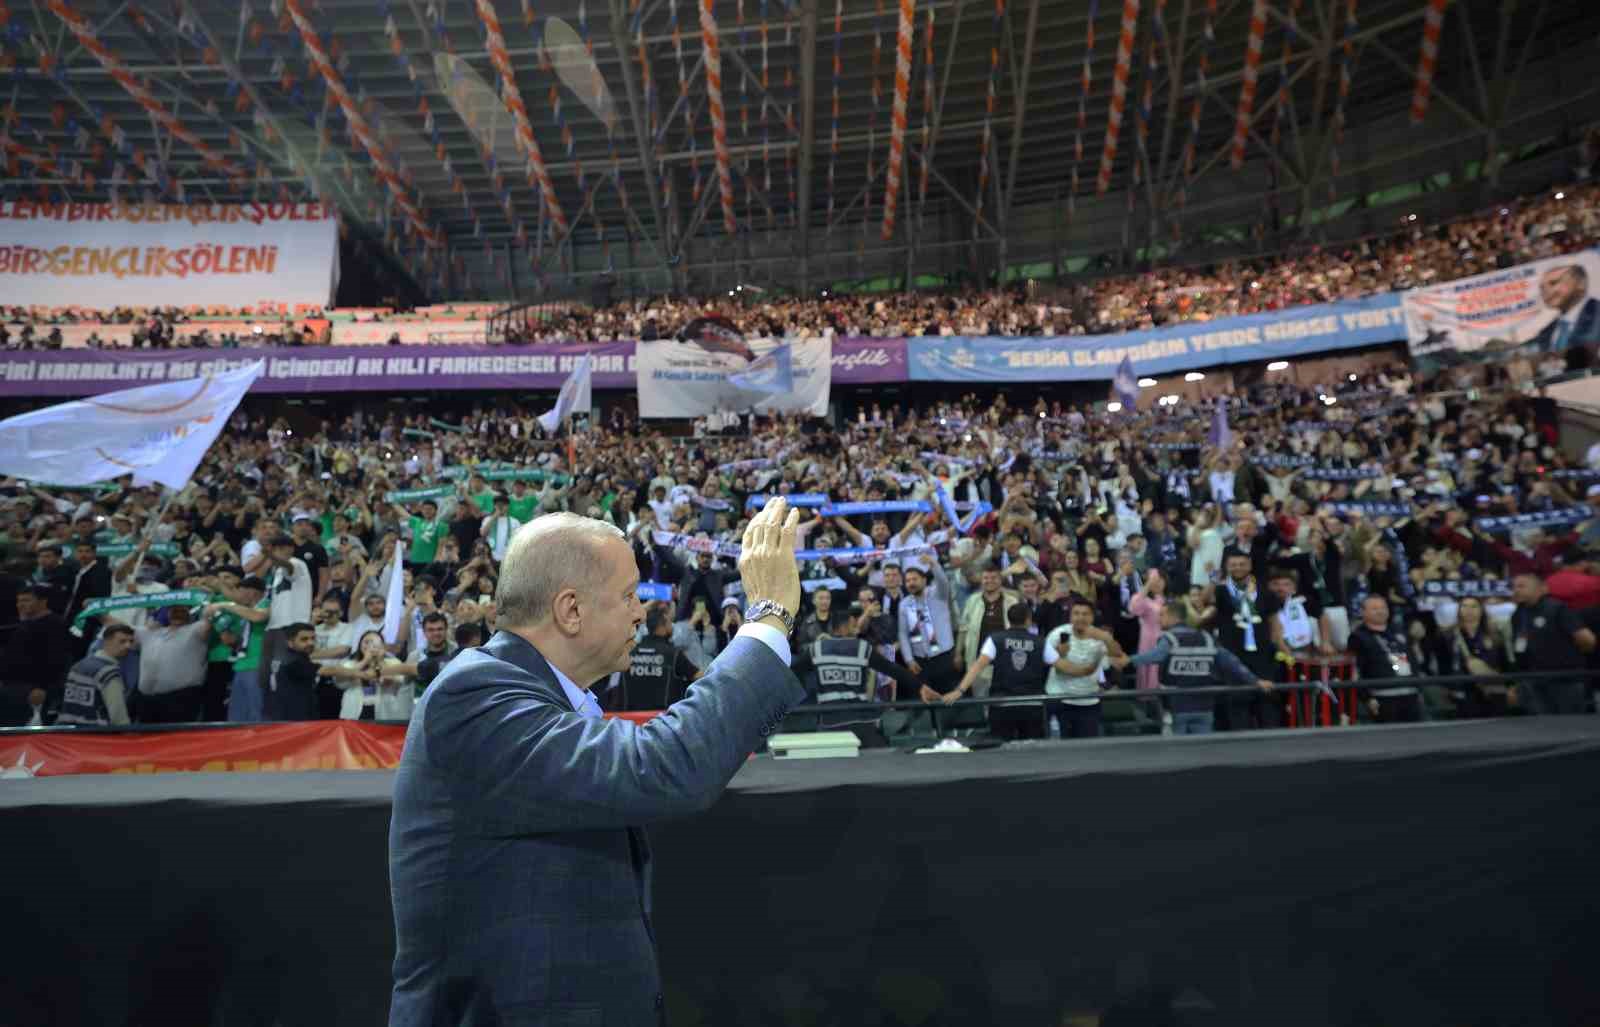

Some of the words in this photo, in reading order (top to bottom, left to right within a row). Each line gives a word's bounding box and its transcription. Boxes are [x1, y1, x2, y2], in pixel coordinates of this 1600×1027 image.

[356, 358, 383, 376] AK
[386, 357, 425, 376] KILI
[1005, 637, 1035, 652] POLİS
[823, 669, 858, 681] POLİS
